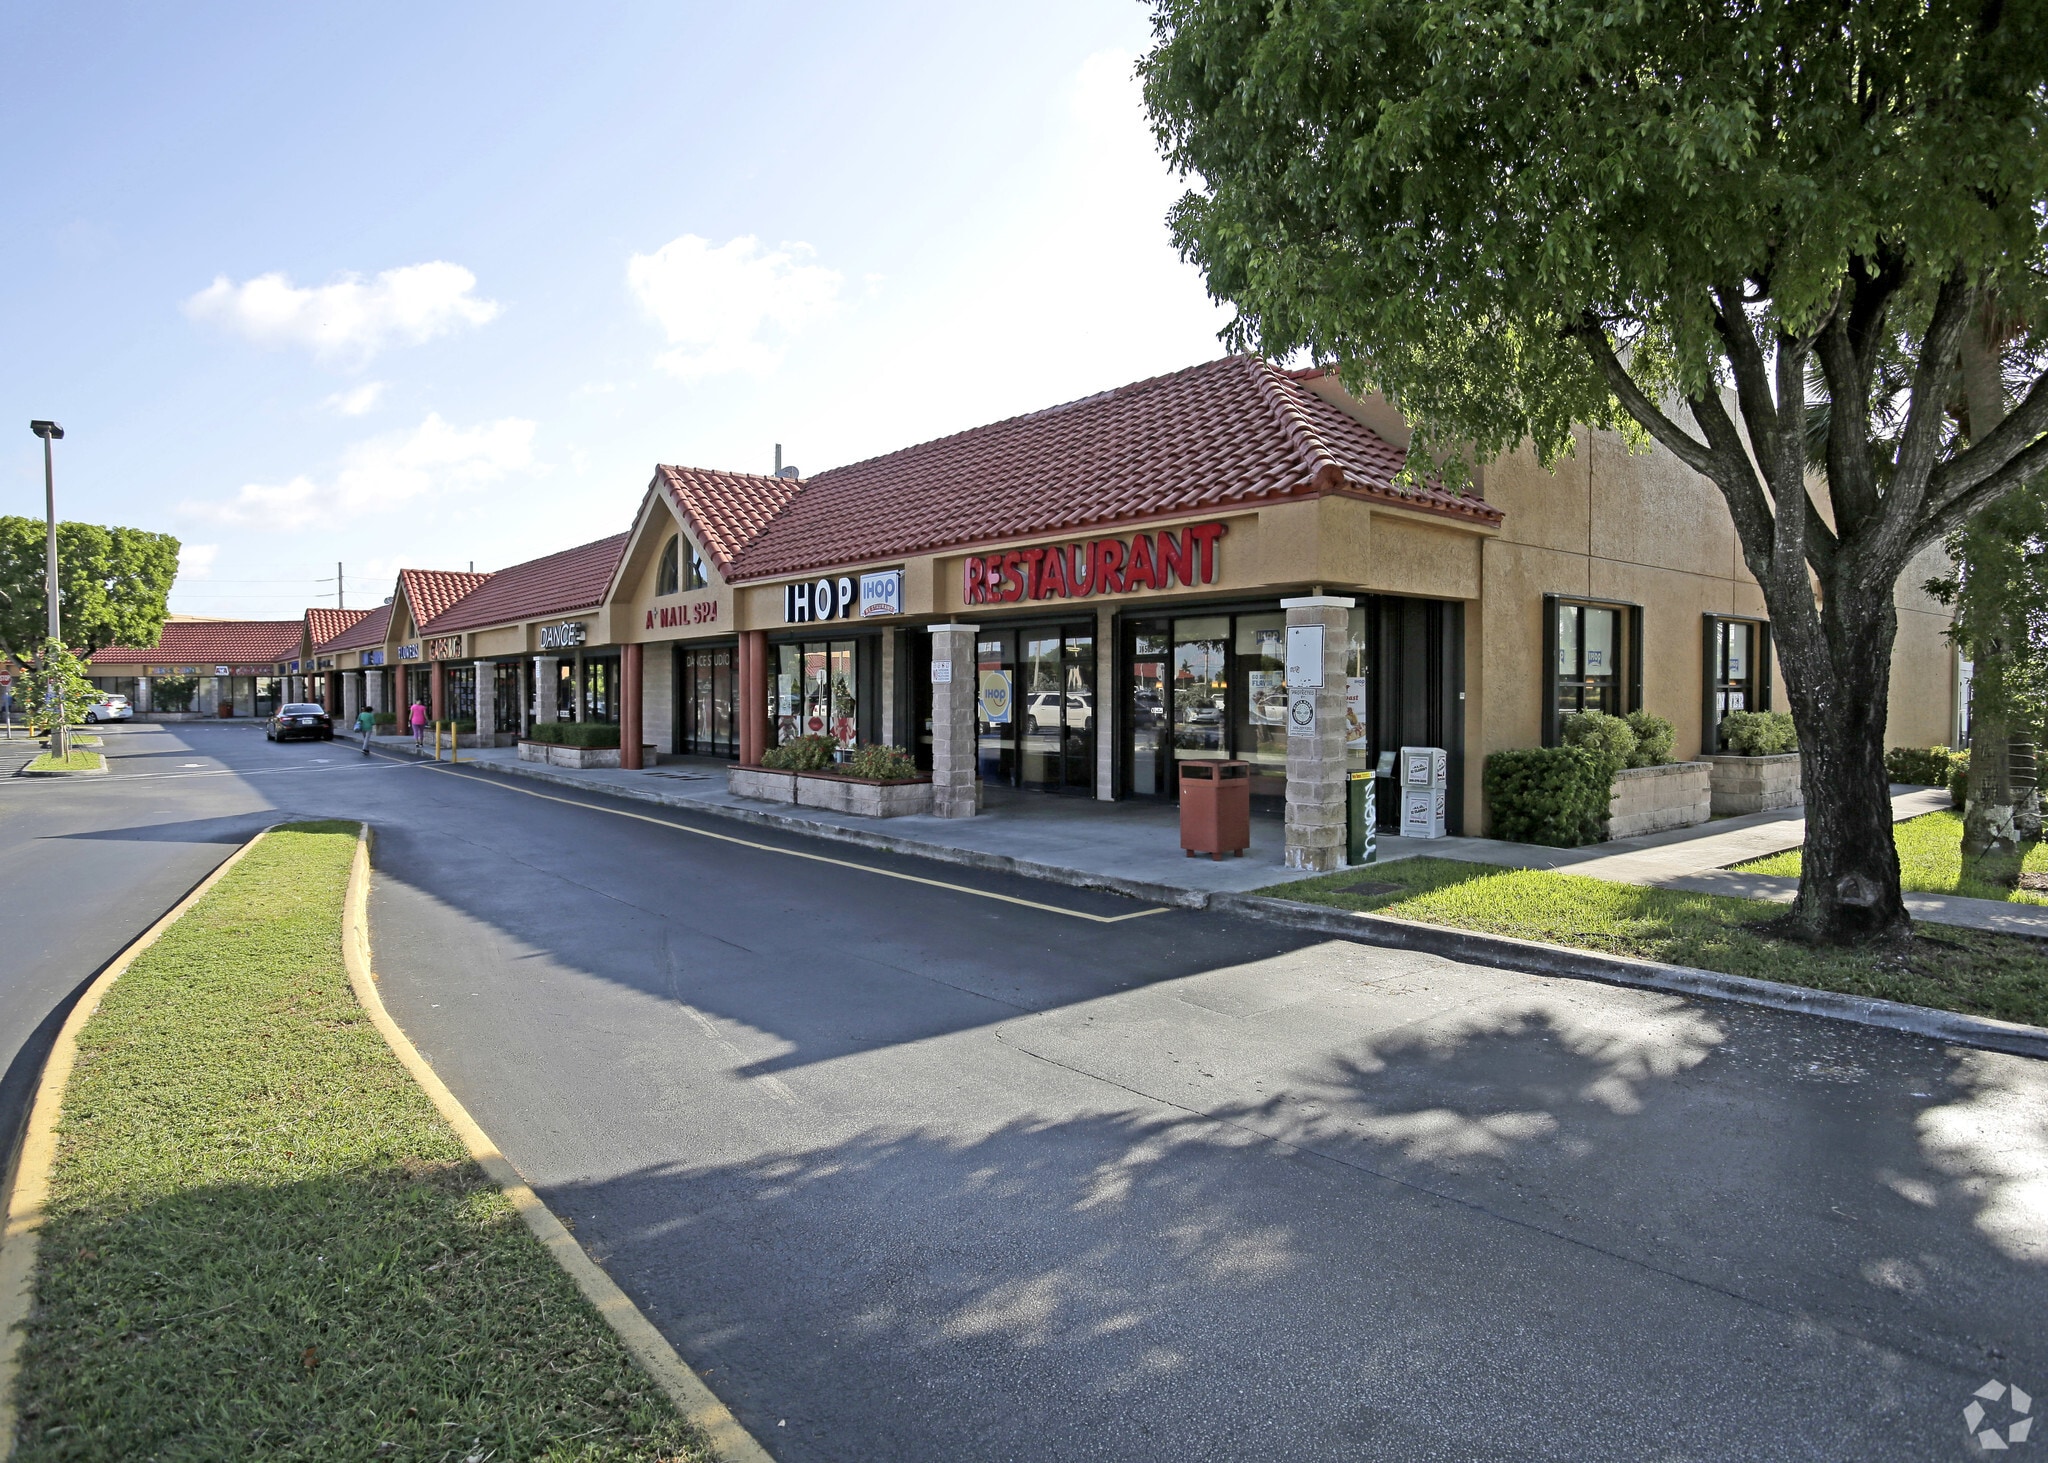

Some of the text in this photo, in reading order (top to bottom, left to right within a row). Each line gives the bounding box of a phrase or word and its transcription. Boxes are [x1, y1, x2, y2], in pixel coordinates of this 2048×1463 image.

[963, 522, 1227, 605] RESTAURANT
[784, 577, 858, 623] IHOP
[863, 579, 895, 603] IHOP
[660, 605, 690, 628] NAIL
[693, 600, 718, 624] SPA
[985, 689, 1006, 702] IHOP
